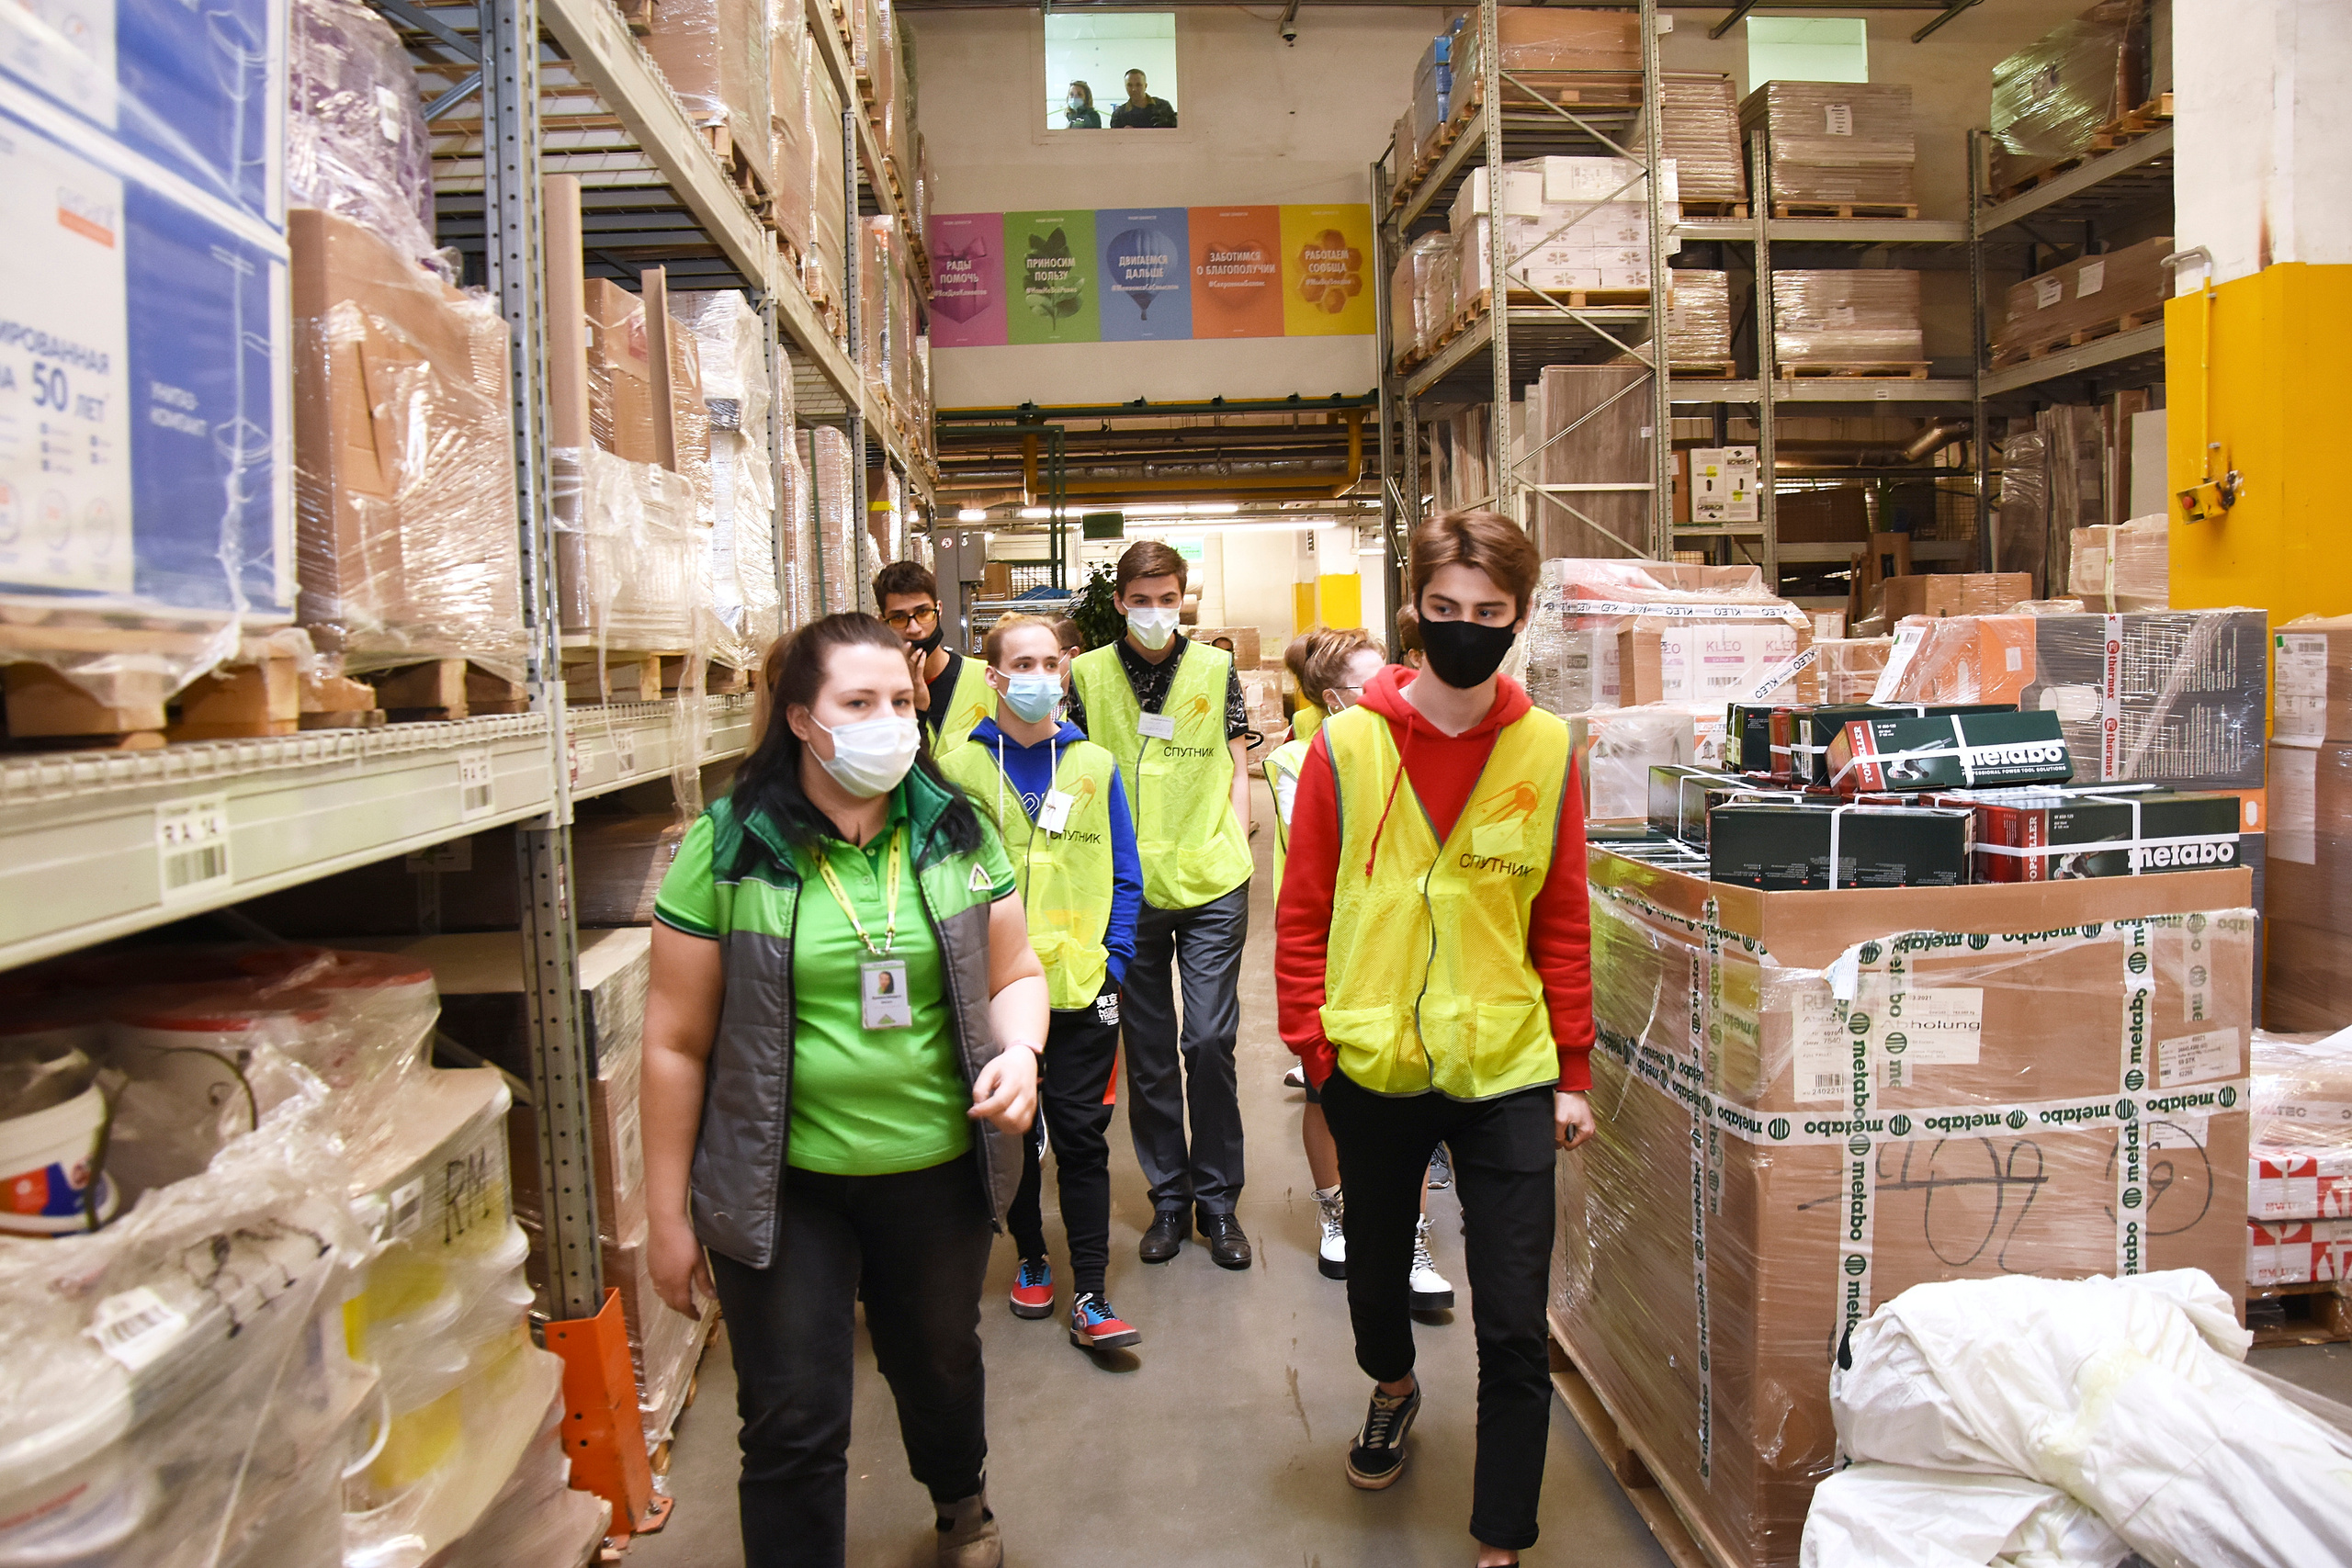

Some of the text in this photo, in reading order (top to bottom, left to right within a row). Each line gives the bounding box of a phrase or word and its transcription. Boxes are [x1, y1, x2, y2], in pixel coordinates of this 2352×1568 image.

[1026, 257, 1076, 268] ПРИНОСИМ
[1118, 254, 1169, 266] ДВИГАЕМСЯ
[1209, 251, 1262, 263] ЗАБОТИМСЯ
[1305, 250, 1350, 261] РАБОТАЕМ
[945, 260, 972, 271] РАДЫ
[1125, 268, 1164, 280] ДАЛЬШЕ
[1196, 264, 1276, 276] О БЛАГОПОЛУЧИИ
[1308, 264, 1347, 274] СООБЩА
[940, 274, 979, 284] ПОМОЧЬ
[1035, 270, 1069, 282] ПОЛЬЗУ
[33, 361, 68, 412] 50
[1713, 607, 1741, 616] KLEO
[1706, 641, 1742, 652] KLEO
[1755, 649, 1816, 699] KLEO KLEO
[2107, 658, 2119, 700] thermex
[1163, 745, 1215, 759] СПУТНИК
[1853, 725, 1874, 783] TOPELLER
[2105, 736, 2118, 777] thermex
[1962, 769, 2001, 777] PESSIONAL
[2029, 816, 2038, 882] OPSLLER
[2128, 842, 2234, 869] metabo
[1459, 852, 1537, 878] СПУТНИК
[1882, 1020, 1980, 1031] Abholung
[2129, 987, 2148, 1064] metabo
[1852, 1040, 1870, 1121] metabo
[2145, 1092, 2215, 1113] metabo
[1716, 1105, 1763, 1134] metabo
[1924, 1112, 2001, 1130] metabo
[2039, 1105, 2111, 1123] metabo
[1804, 1118, 1883, 1137] metabo
[1692, 1160, 1702, 1236] metabo
[1849, 1161, 1868, 1241] metabo
[2122, 1221, 2139, 1276] etabo
[1697, 1272, 1708, 1351] metabo
[1846, 1281, 1863, 1335] meta
